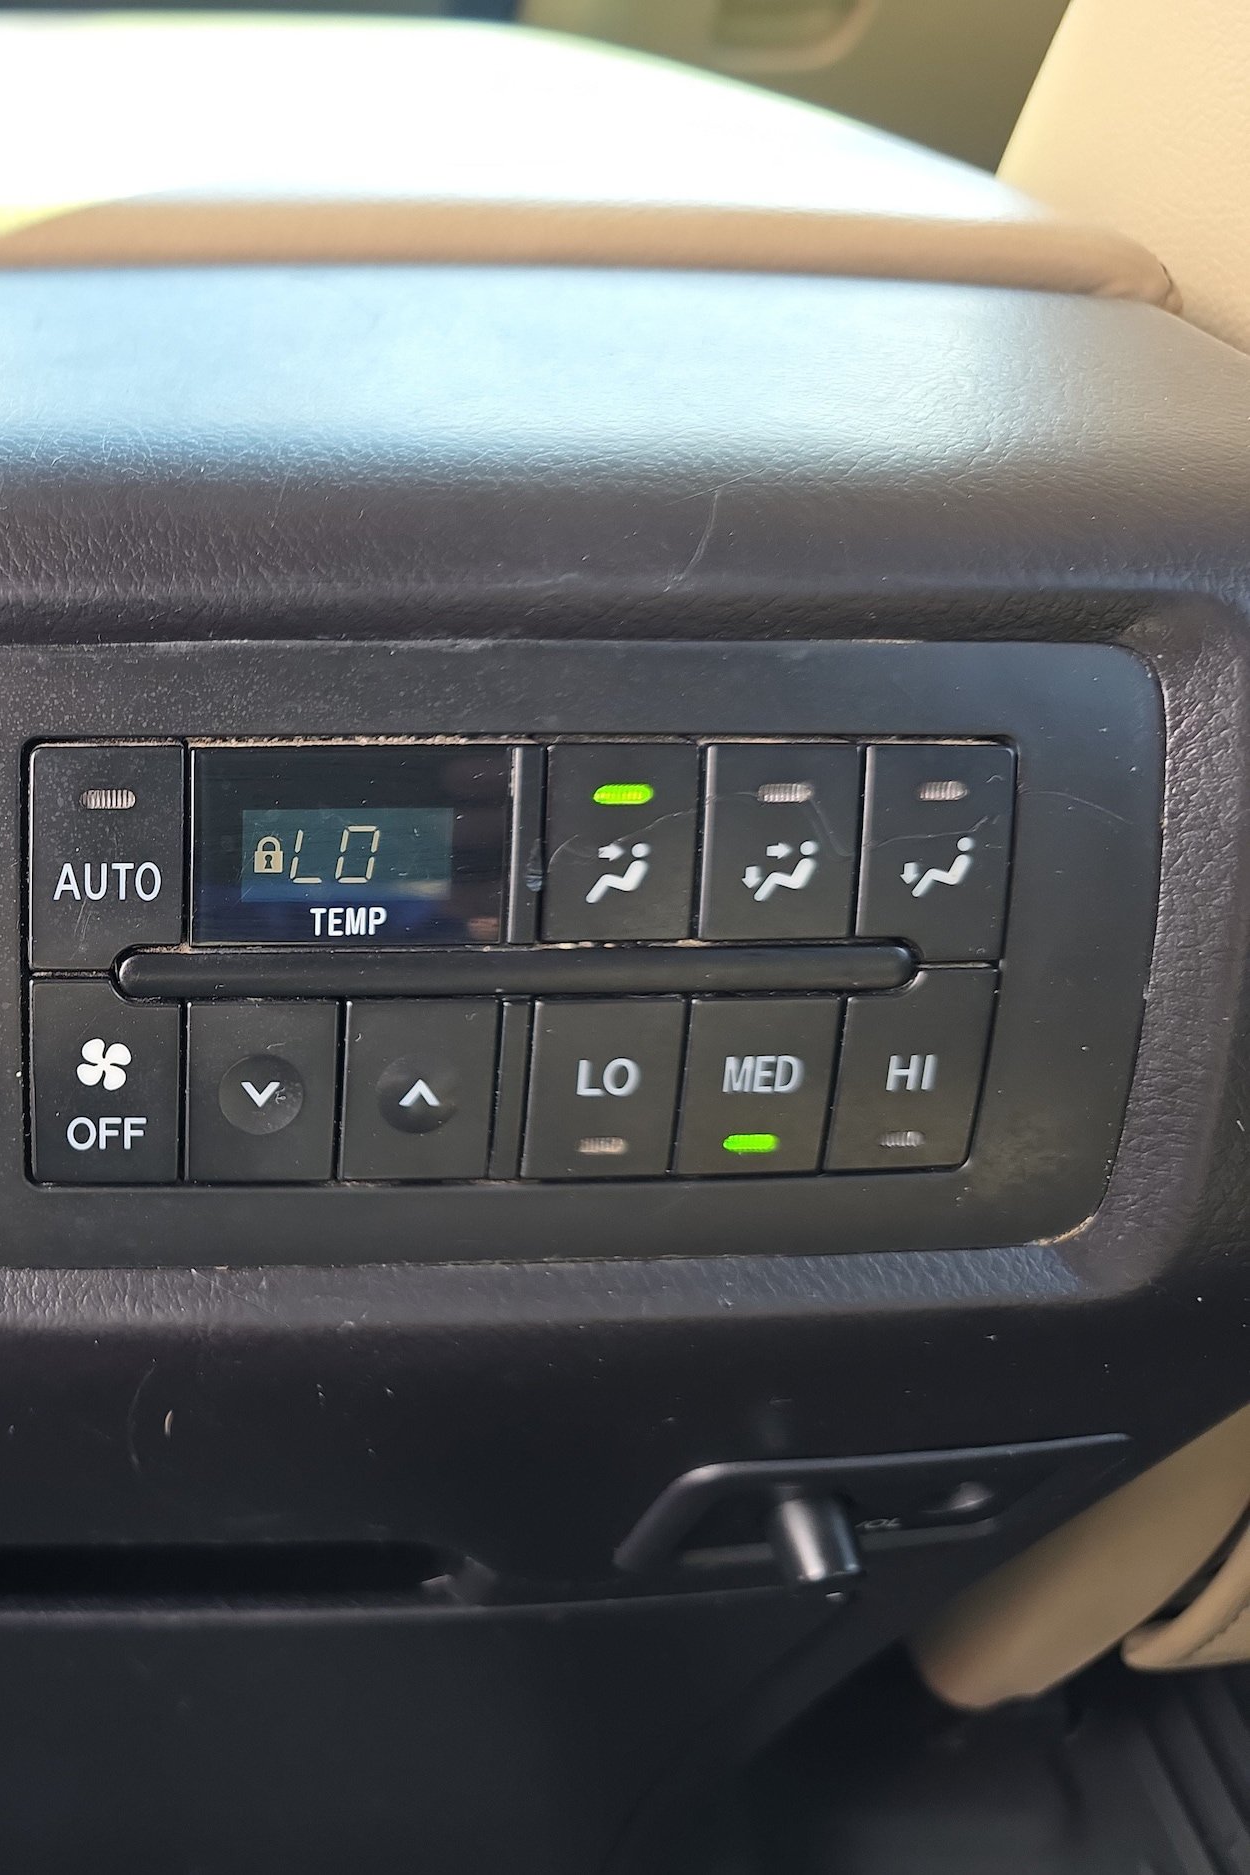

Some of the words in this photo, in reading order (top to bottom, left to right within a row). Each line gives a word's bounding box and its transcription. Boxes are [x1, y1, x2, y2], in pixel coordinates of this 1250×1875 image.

[289, 824, 381, 885] LO
[52, 861, 163, 902] AUTO
[309, 906, 388, 937] TEMP
[574, 1056, 641, 1098] LO
[721, 1054, 805, 1094] MED
[884, 1052, 938, 1092] HI
[65, 1115, 148, 1152] OFF
